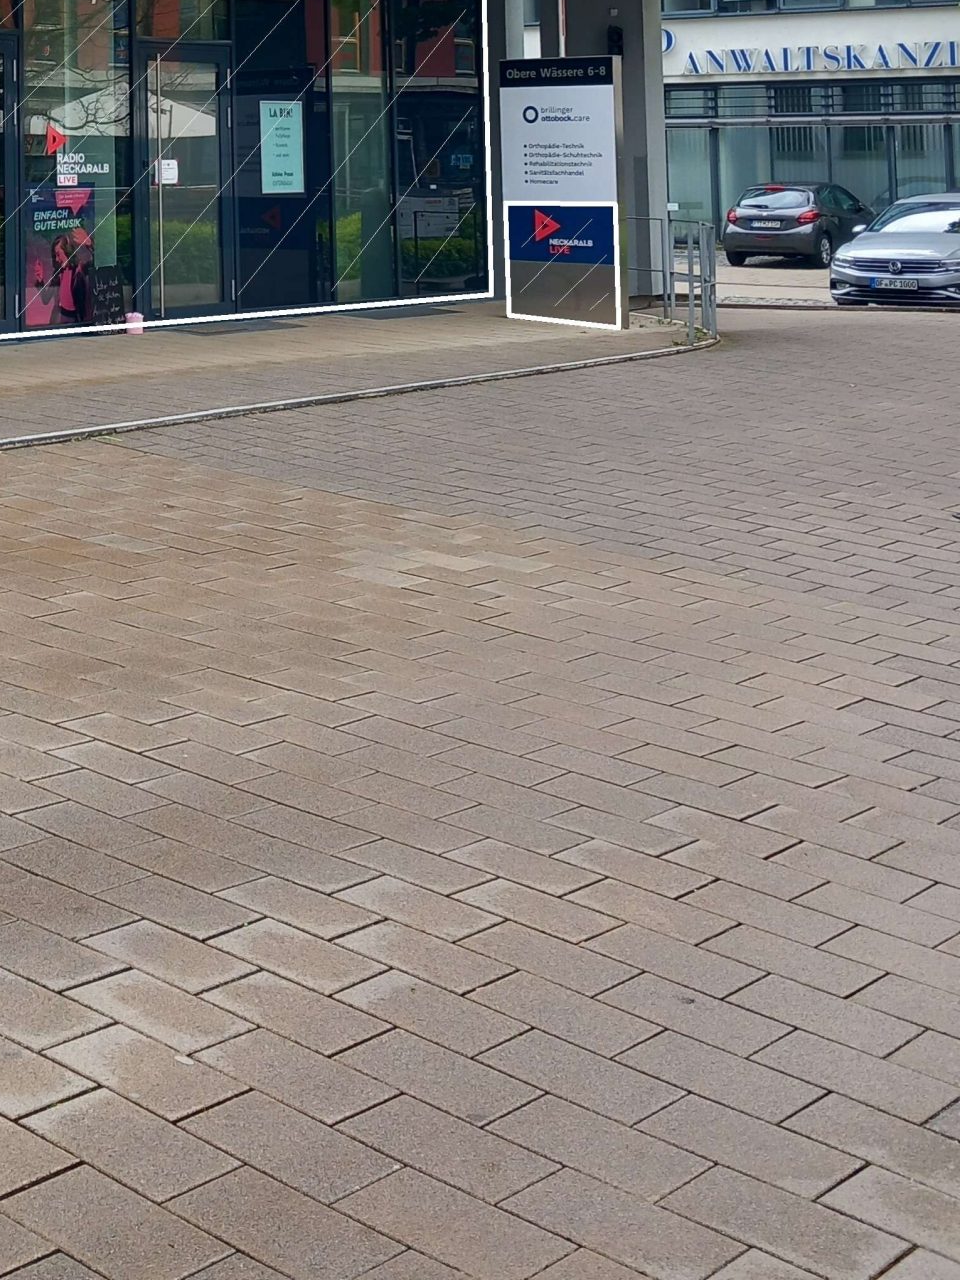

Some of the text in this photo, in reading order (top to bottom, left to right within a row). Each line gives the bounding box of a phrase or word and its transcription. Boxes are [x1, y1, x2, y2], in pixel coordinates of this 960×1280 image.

[506, 65, 606, 79] Obere Wässere 6-8
[540, 106, 574, 115] brillinger
[540, 114, 591, 122] ottobock.care
[56, 153, 85, 164] RADIO
[56, 163, 110, 174] NECKARALB
[58, 175, 77, 184] LIVE
[34, 209, 69, 221] EINFACH
[34, 218, 82, 231] GUTE MUSIK
[549, 246, 571, 254] LIVE
